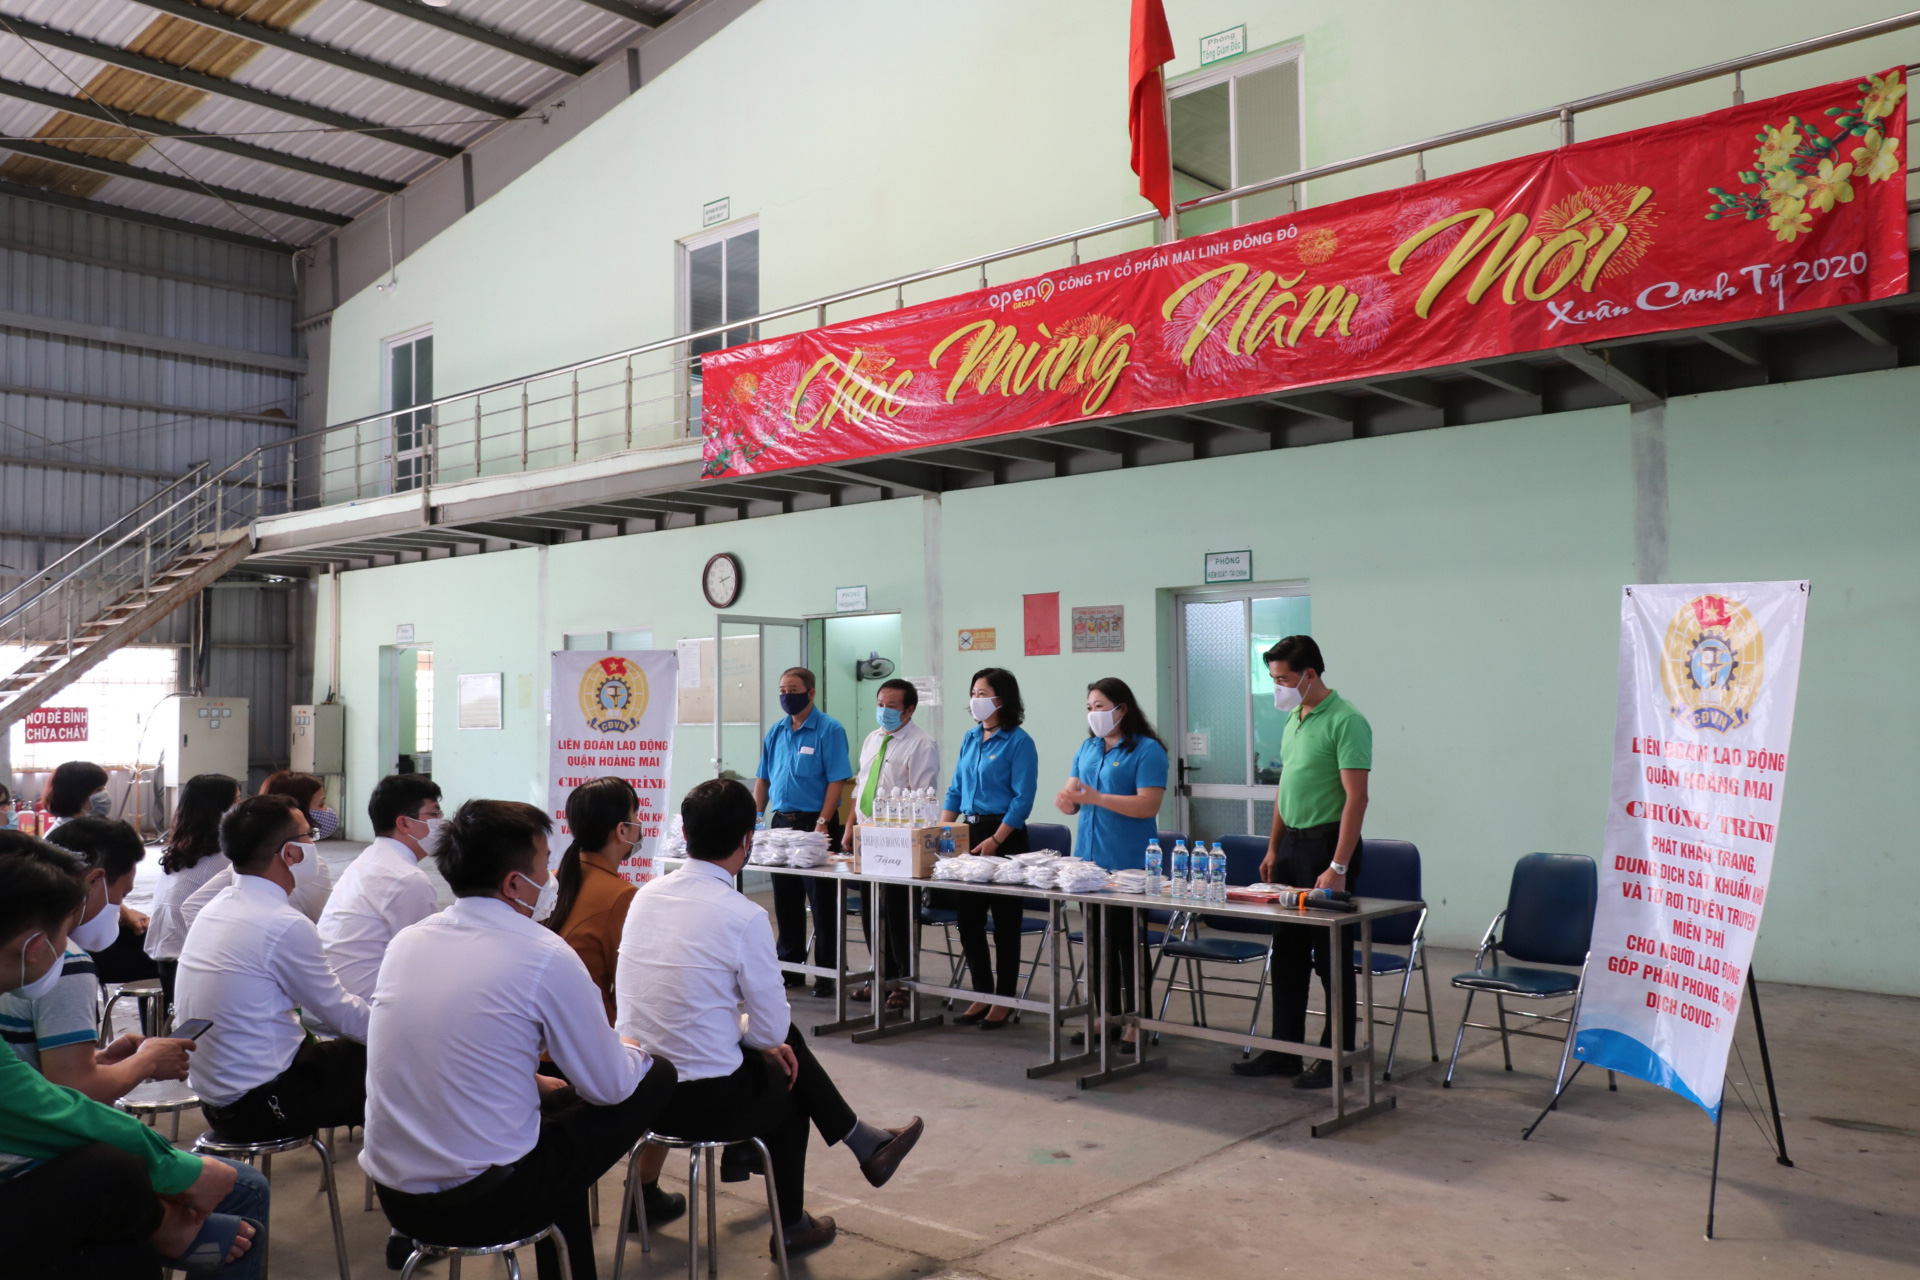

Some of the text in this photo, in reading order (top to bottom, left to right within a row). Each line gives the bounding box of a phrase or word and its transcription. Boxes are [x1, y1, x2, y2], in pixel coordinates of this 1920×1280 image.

[1059, 223, 1298, 292] CÔNG TY CỔ PHẦN MAI LINH ĐÔNG ĐÔ
[1013, 298, 1036, 310] GROUP
[1547, 251, 1867, 331] Xuân Canh Tý 2020
[790, 186, 1654, 432] Chúc Mừng Năm Mới
[26, 708, 88, 724] NƠI ĐỂ BÌNH
[601, 721, 626, 732] CĐVN
[1691, 709, 1728, 729] CĐVN
[26, 725, 87, 740] CHỮA CHÁY
[558, 738, 668, 753] LIÊN ĐOÀN LAO ĐỘNG
[567, 754, 660, 768] QUẬN HOÀNG MAI
[1632, 735, 1785, 774] LIÊN ĐOÀN LAO ĐỘNG
[1646, 765, 1773, 801] QUẬN HOÀNG MAI
[1626, 800, 1710, 831] CHƯƠNG
[631, 856, 653, 869] ĐỘNG
[873, 854, 902, 866] Tặng
[1652, 835, 1757, 876] PHÁT KHẨU TRANG,
[1614, 855, 1657, 877] DUNG
[1660, 863, 1685, 884] DỊCH
[1688, 869, 1710, 890] SÁT
[1714, 875, 1752, 901] KHUẨN
[1622, 880, 1643, 900] VÀ
[1666, 891, 1684, 911] RƠI
[1687, 898, 1724, 921] TUYÊN
[1673, 917, 1726, 949] MIỄN PHÍ
[1626, 934, 1741, 986] CHO NGƯỜI LAO ĐỘNG
[1607, 956, 1639, 976] GÓP
[1642, 964, 1679, 989] PHẦN
[1682, 978, 1721, 1007] PHÒNG,
[1646, 991, 1678, 1015] DỊCH
